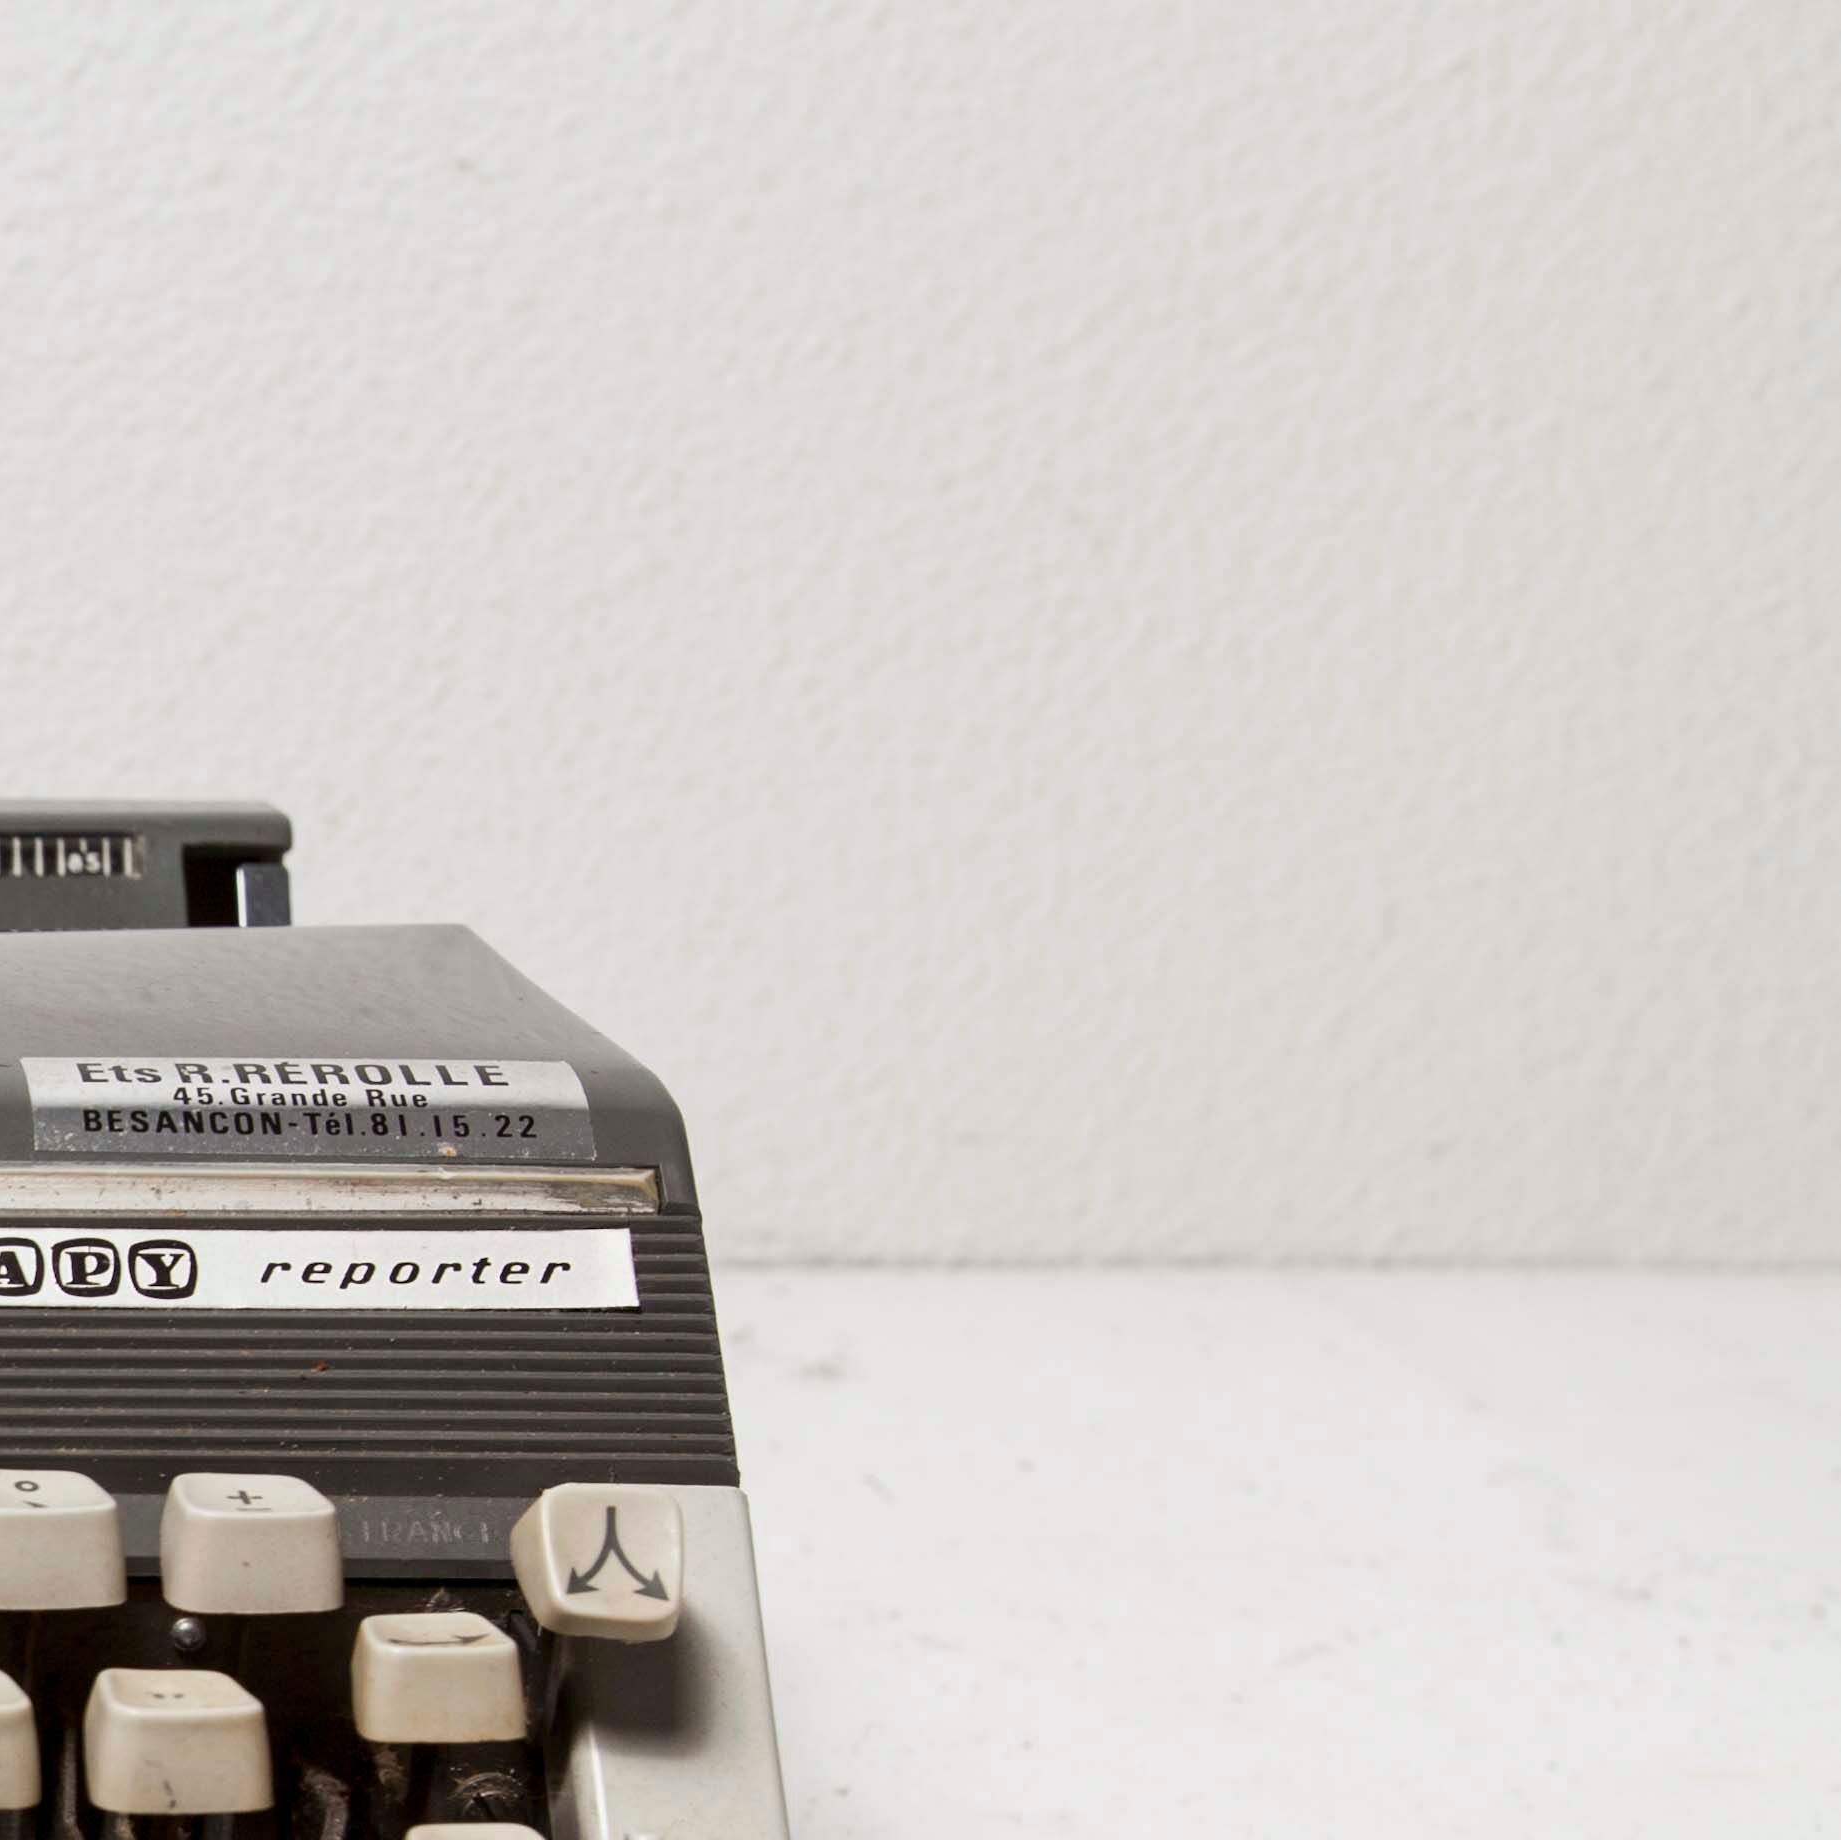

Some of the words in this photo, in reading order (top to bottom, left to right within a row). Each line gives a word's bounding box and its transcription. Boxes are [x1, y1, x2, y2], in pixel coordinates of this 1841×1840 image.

[68, 853, 102, 873] 85
[76, 1062, 163, 1084] Ets
[365, 1088, 429, 1109] Rue
[260, 1257, 572, 1289] reporter
